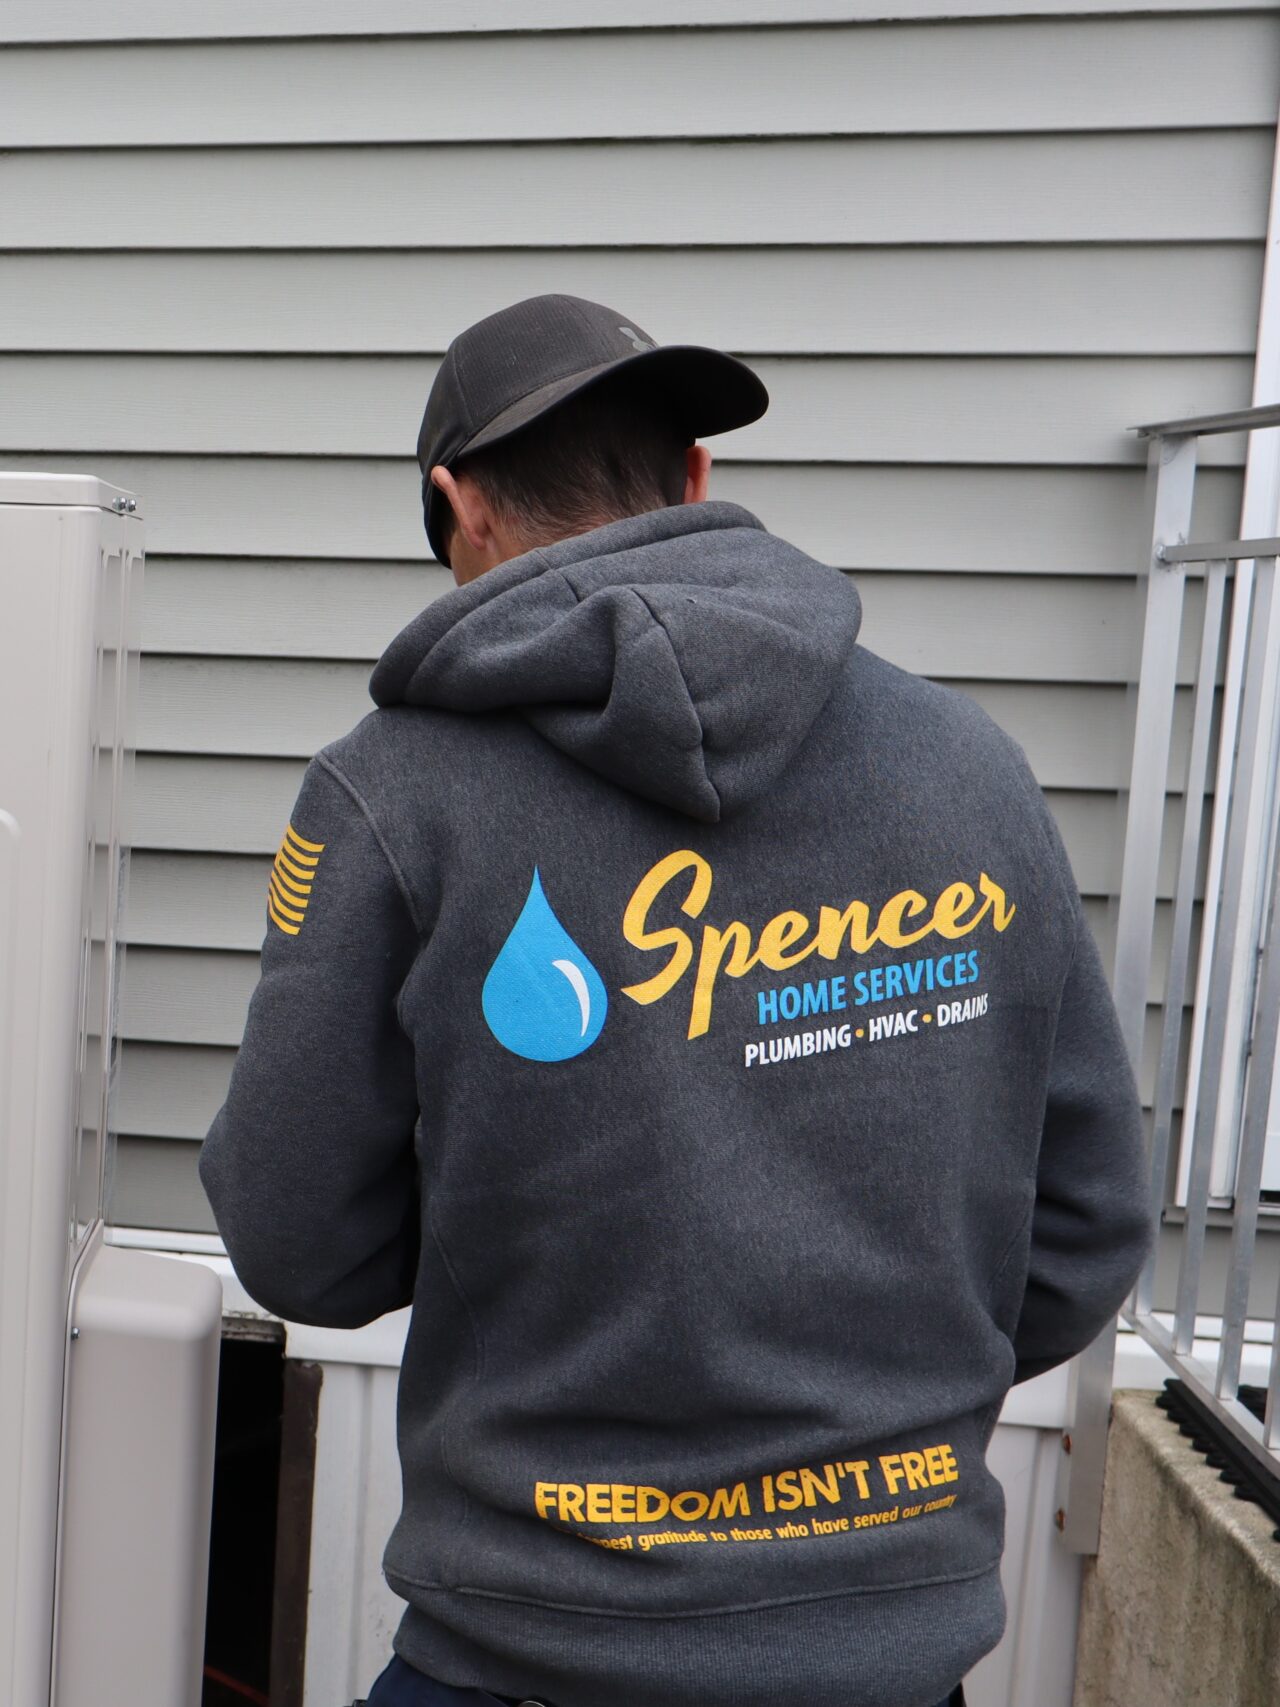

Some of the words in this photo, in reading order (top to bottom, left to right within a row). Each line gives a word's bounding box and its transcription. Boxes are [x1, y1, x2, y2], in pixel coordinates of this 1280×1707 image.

[621, 849, 1016, 1040] Spencer
[757, 976, 847, 1025] HOME
[853, 950, 979, 1006] SERVICES
[745, 1024, 851, 1067] PLUMBING
[869, 1009, 918, 1042] HVAC
[937, 992, 989, 1027] DRAINS
[535, 1481, 751, 1523] FREEDOM
[762, 1460, 870, 1513] ISN'T
[878, 1444, 959, 1495] FREE
[638, 1530, 708, 1551] gratitude
[712, 1530, 728, 1542] to
[730, 1527, 773, 1542] those
[775, 1521, 809, 1539] who
[812, 1517, 850, 1536] have
[854, 1506, 899, 1529] served
[902, 1504, 924, 1520] our
